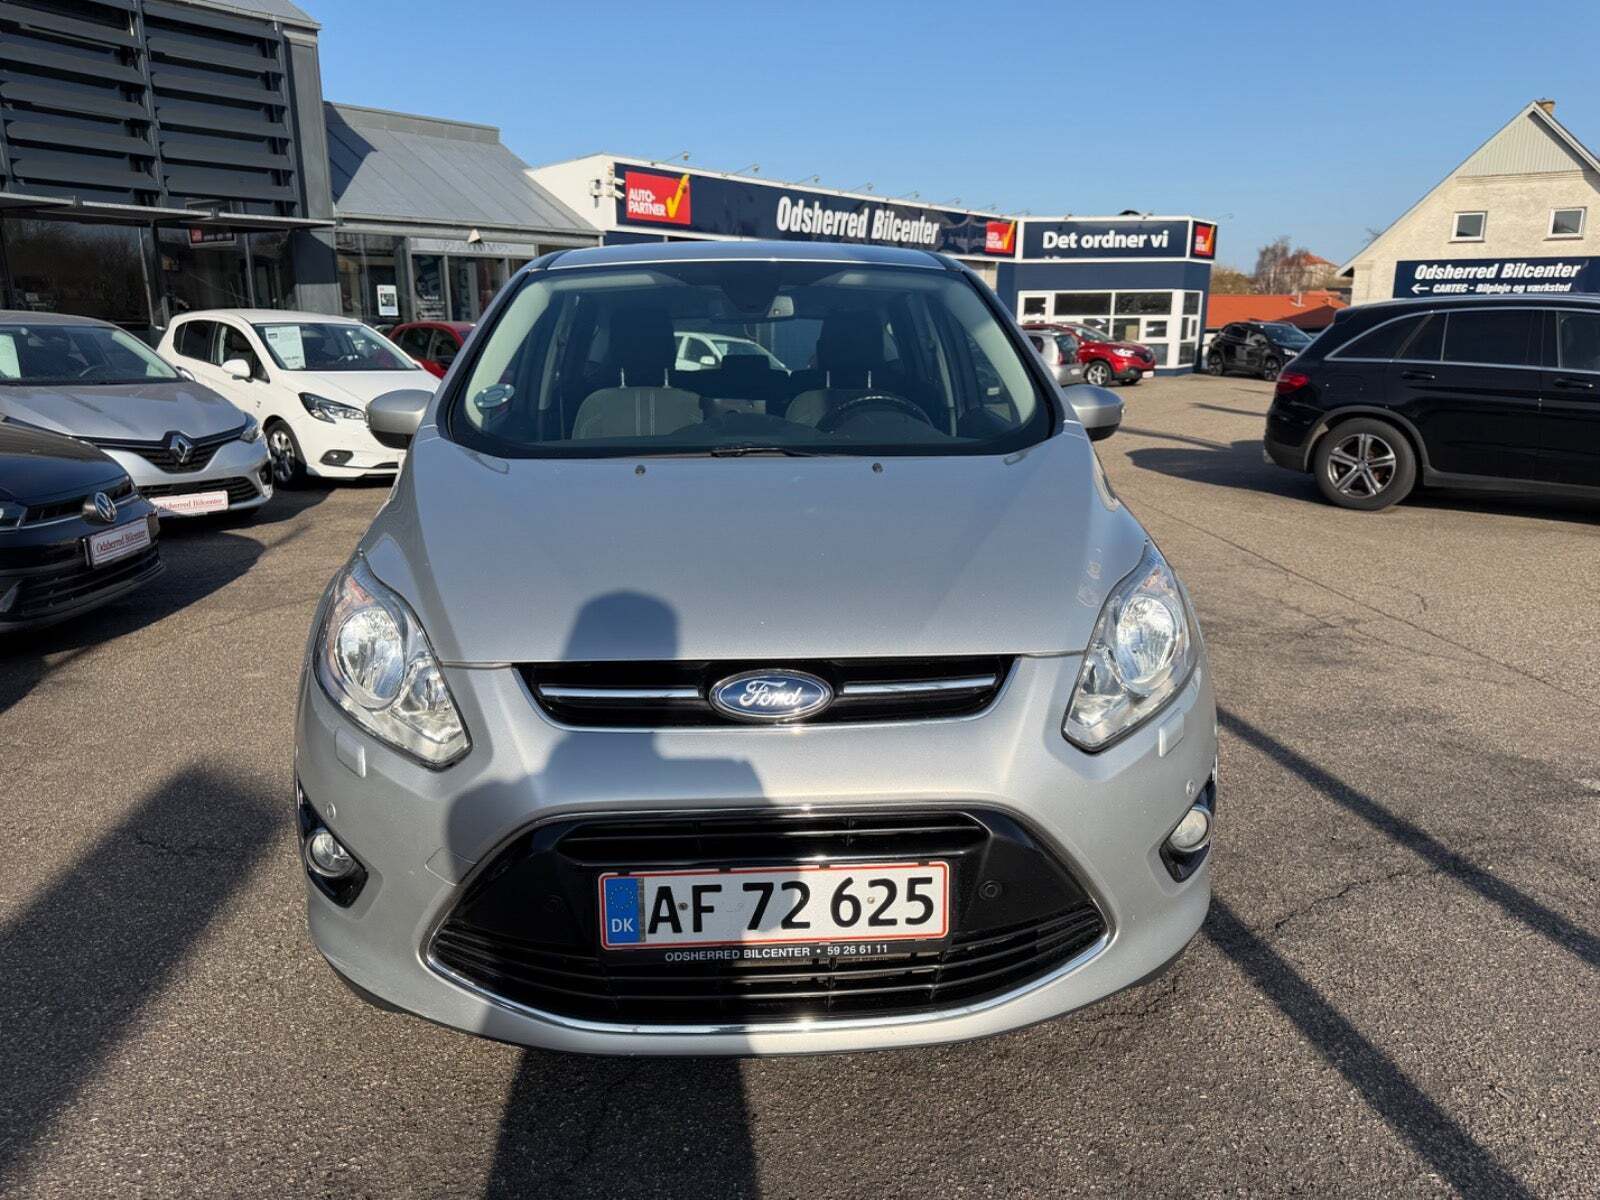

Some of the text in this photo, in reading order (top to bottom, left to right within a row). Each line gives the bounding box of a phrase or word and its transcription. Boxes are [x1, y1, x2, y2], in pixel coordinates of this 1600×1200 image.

[628, 188, 656, 202] AUTO-
[628, 201, 666, 217] PARTNER
[776, 196, 939, 244] Odsherred Bilcenter
[1042, 230, 1169, 249] Det ordner vi
[1415, 262, 1581, 280] Odsherred Bilcenter
[1432, 283, 1470, 293] CARTEC
[1513, 285, 1524, 294] og
[1526, 283, 1572, 293] værksted
[739, 680, 802, 707] Ford
[648, 876, 934, 934] AF 72 625
[611, 918, 634, 933] DK
[665, 944, 888, 962] ODSHERRED BILCENTER 59 26 61 11
